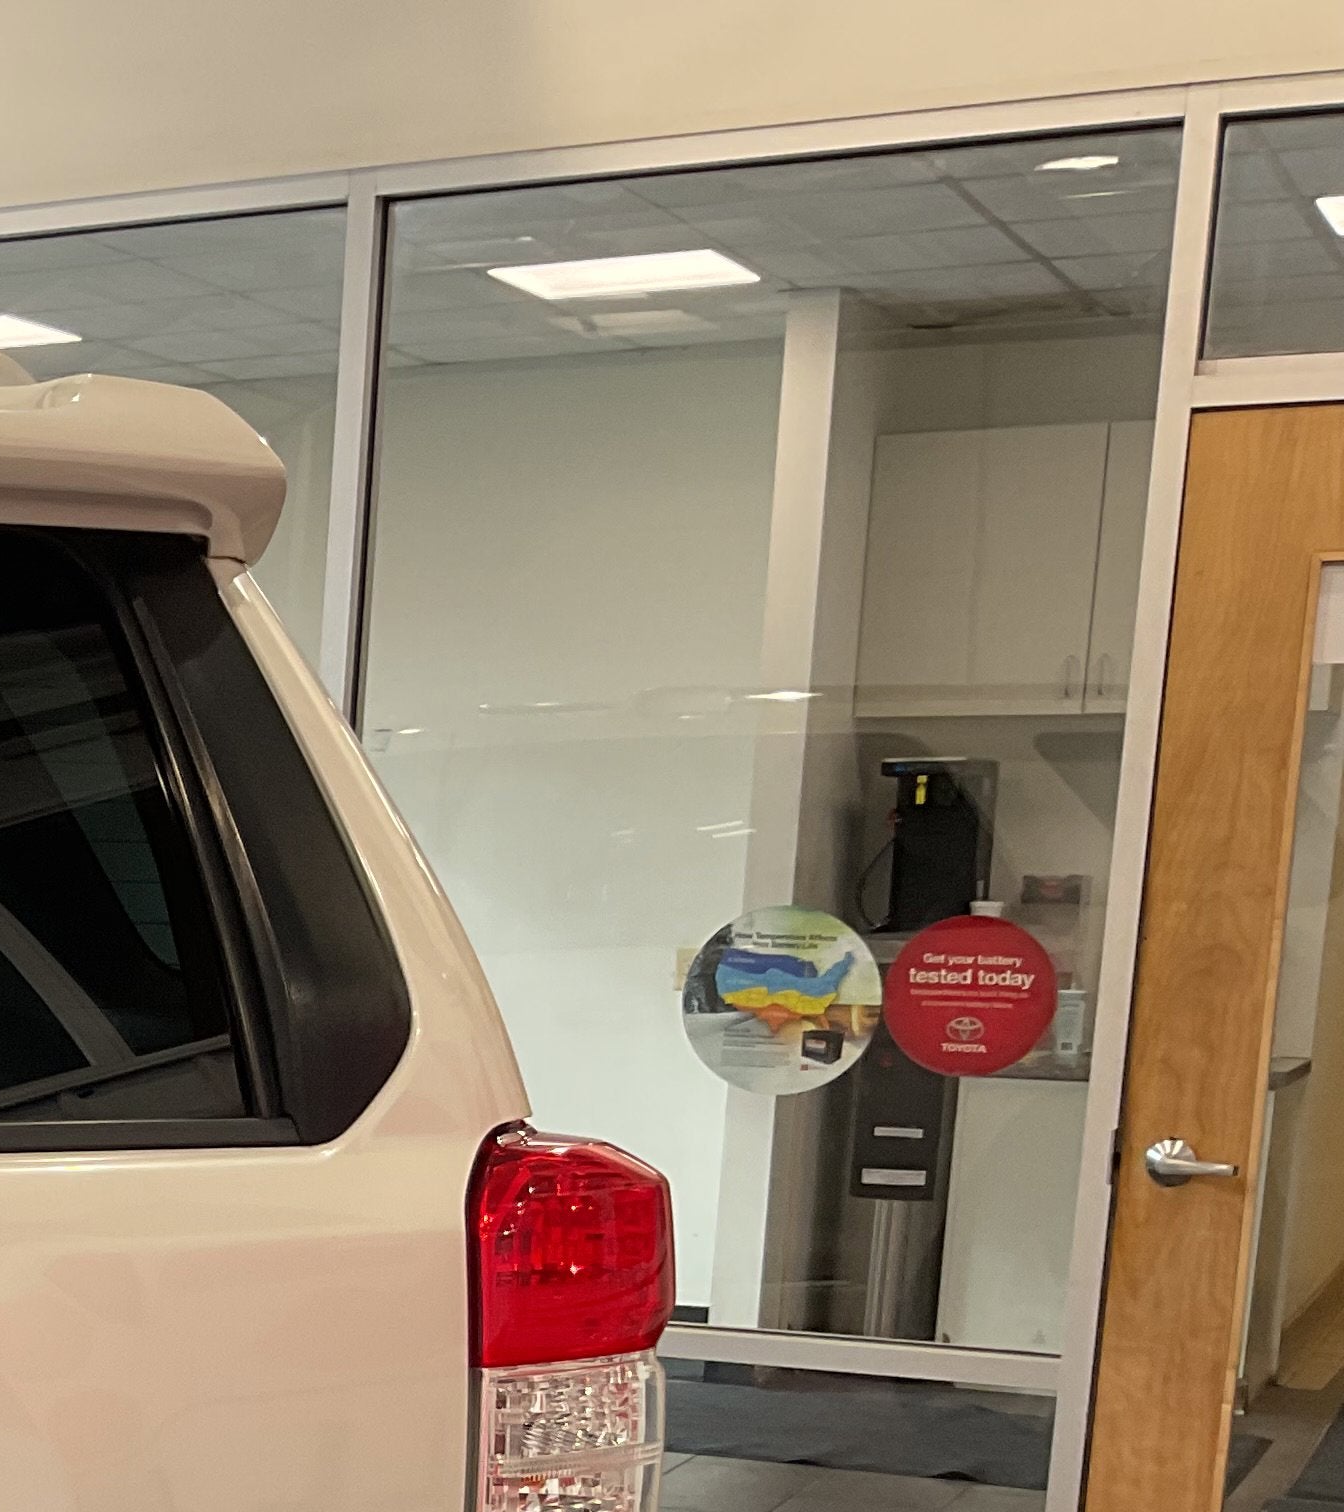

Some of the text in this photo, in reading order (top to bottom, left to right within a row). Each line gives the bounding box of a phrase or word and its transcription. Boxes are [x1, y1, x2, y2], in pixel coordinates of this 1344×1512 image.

[923, 953, 1023, 968] Get your battery
[909, 968, 1035, 990] tested today
[941, 1043, 987, 1053] TOYOTA
